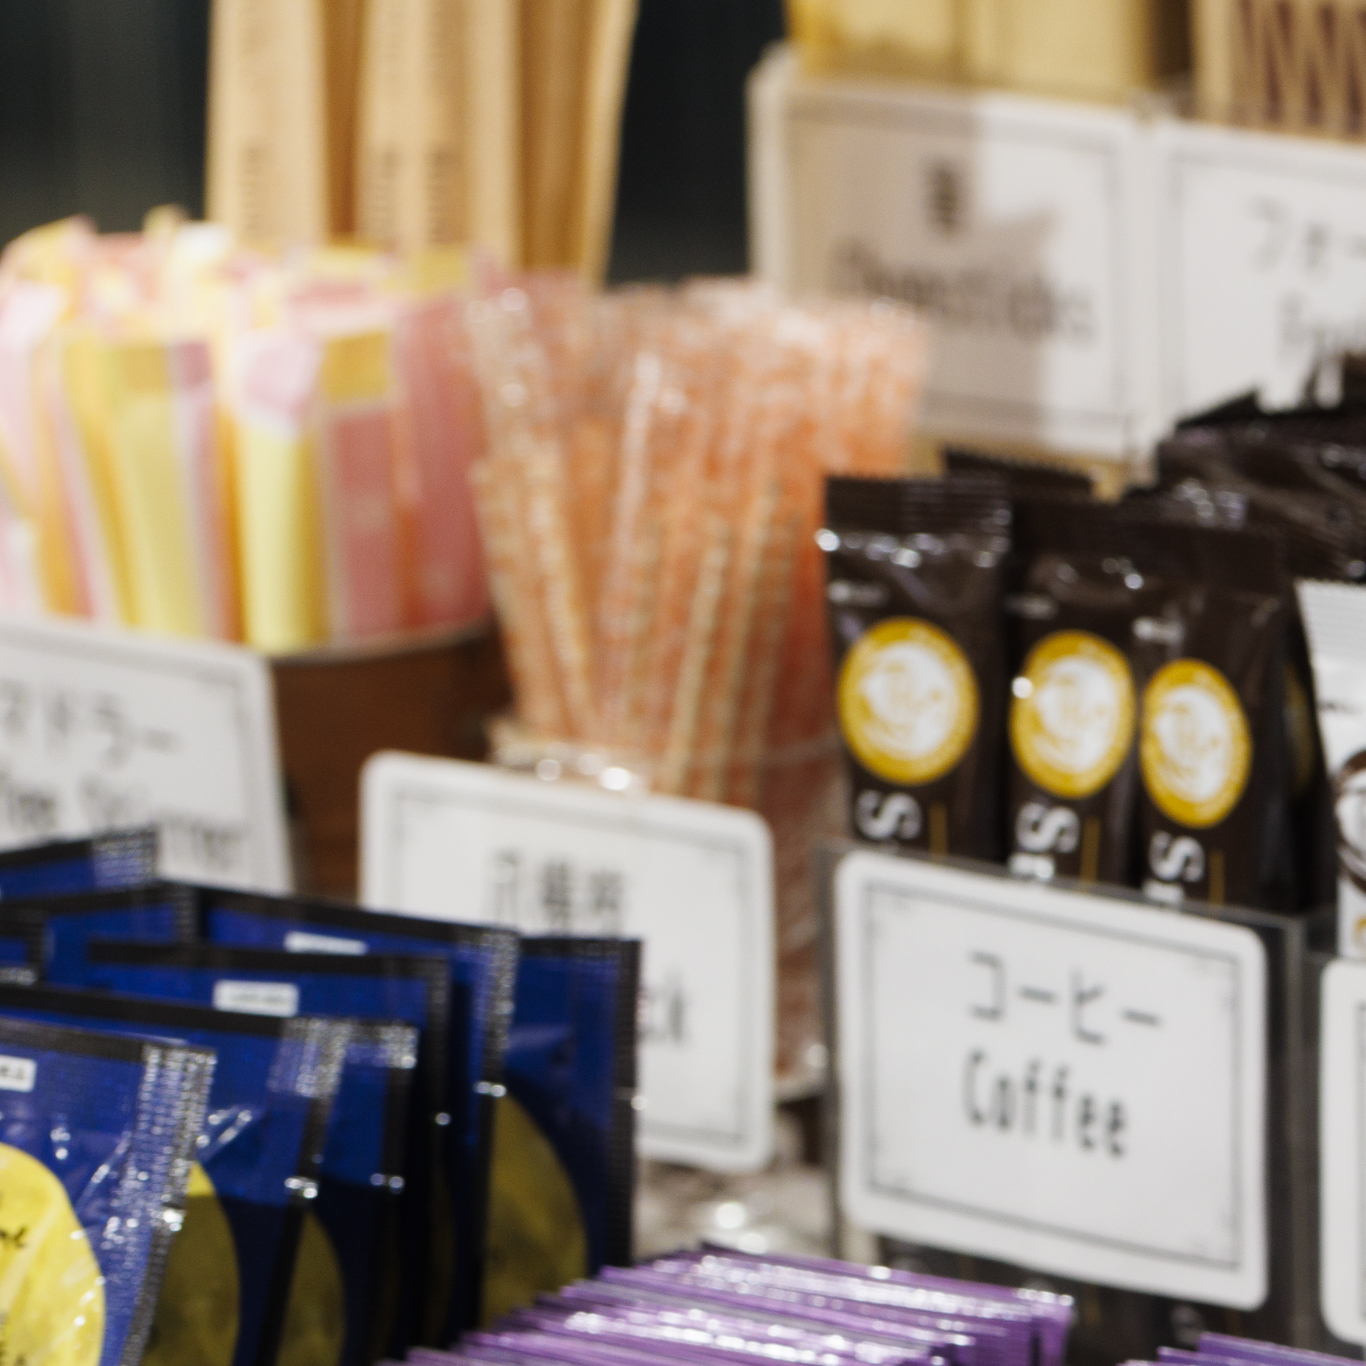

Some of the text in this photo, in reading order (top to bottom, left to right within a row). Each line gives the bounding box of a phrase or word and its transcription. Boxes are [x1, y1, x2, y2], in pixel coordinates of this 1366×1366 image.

[967, 951, 1164, 1046] コーヒー
[963, 1047, 1131, 1159] Coffee
